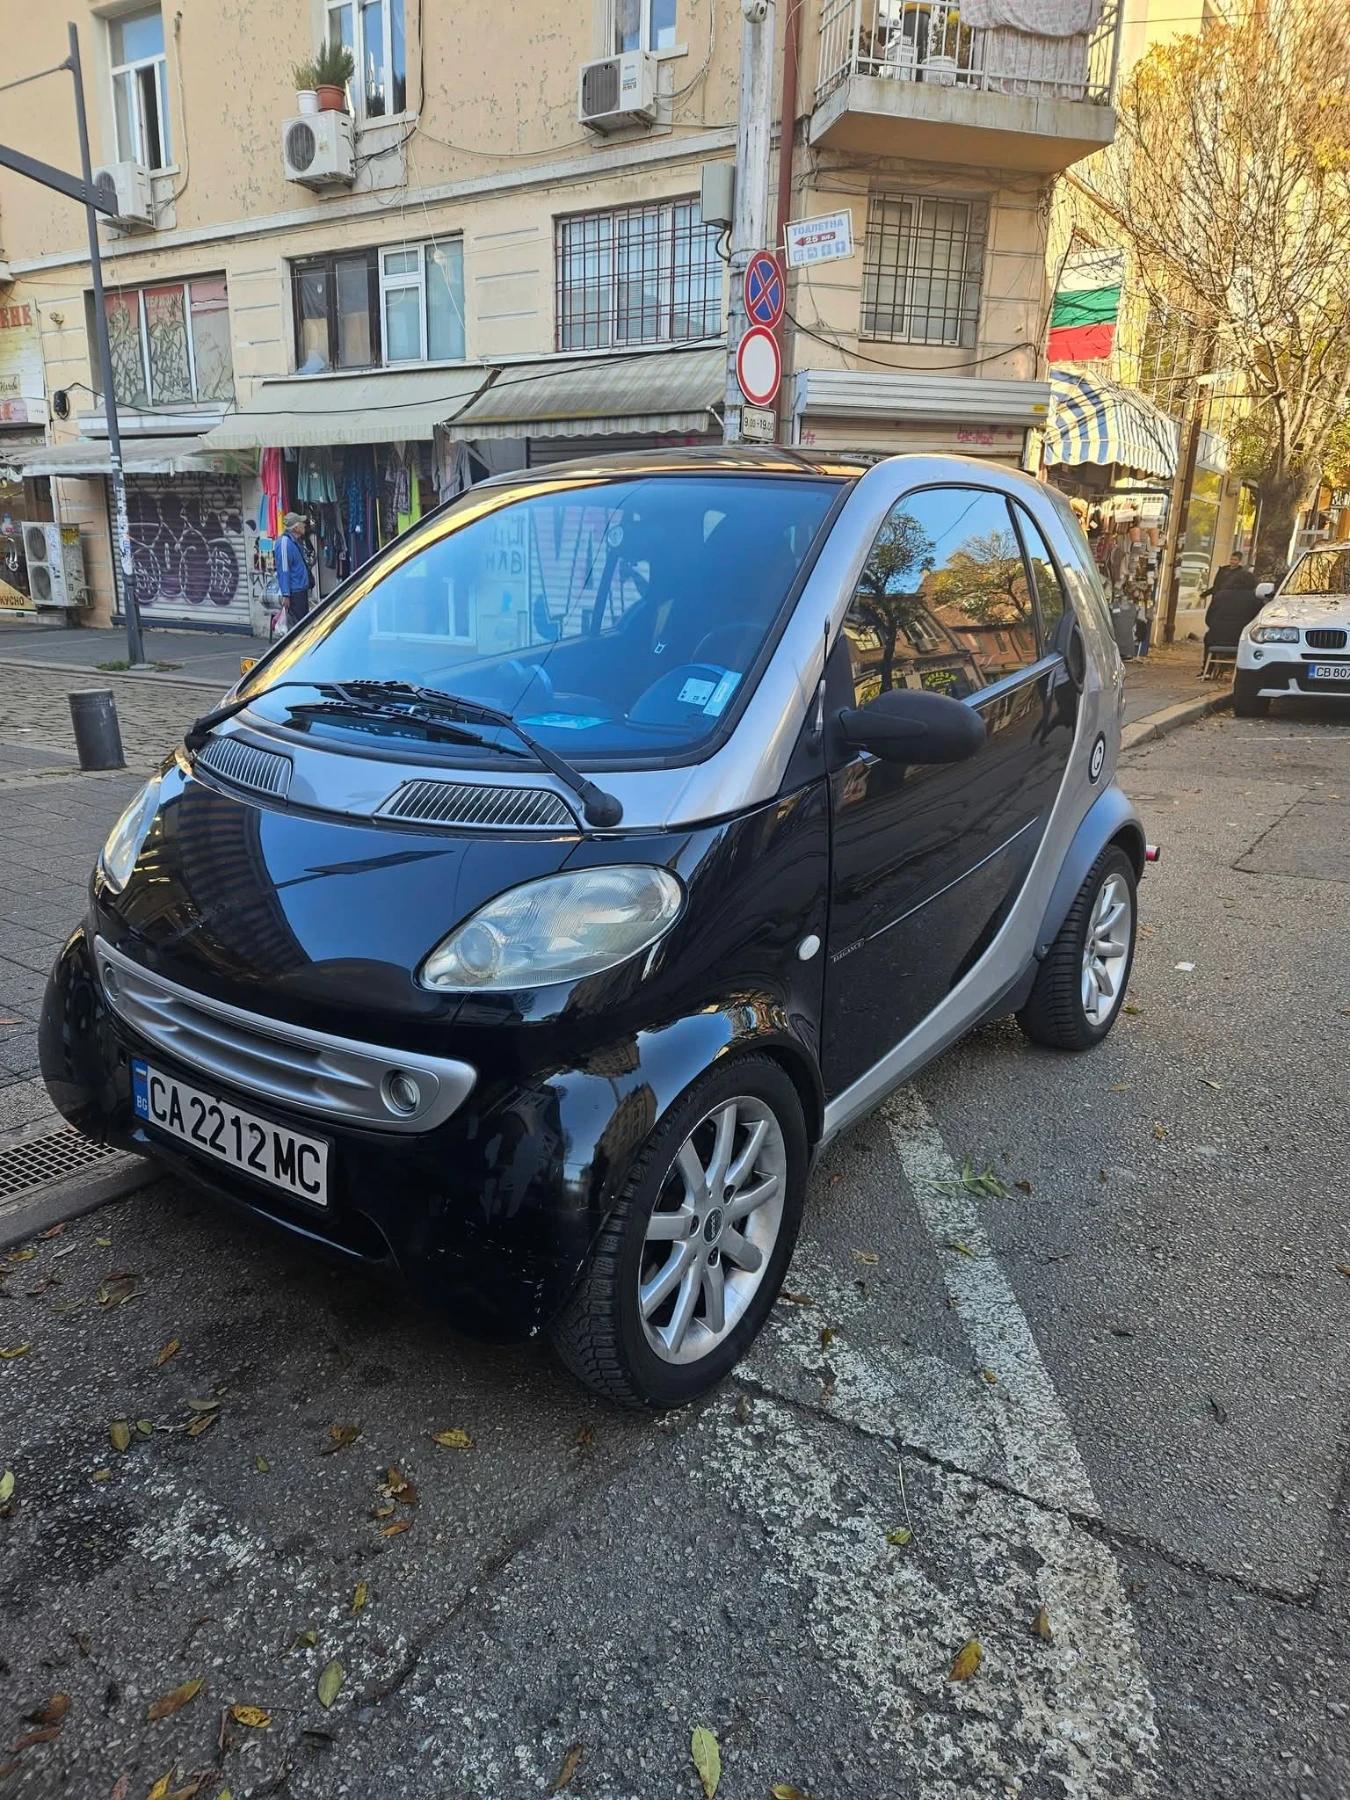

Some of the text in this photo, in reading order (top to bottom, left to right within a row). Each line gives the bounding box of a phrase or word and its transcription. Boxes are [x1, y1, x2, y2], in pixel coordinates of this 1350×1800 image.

[792, 218, 844, 236] ТОАЛЕТНА
[805, 236, 818, 244] 25
[1316, 667, 1331, 678] CB
[136, 1094, 148, 1111] BG
